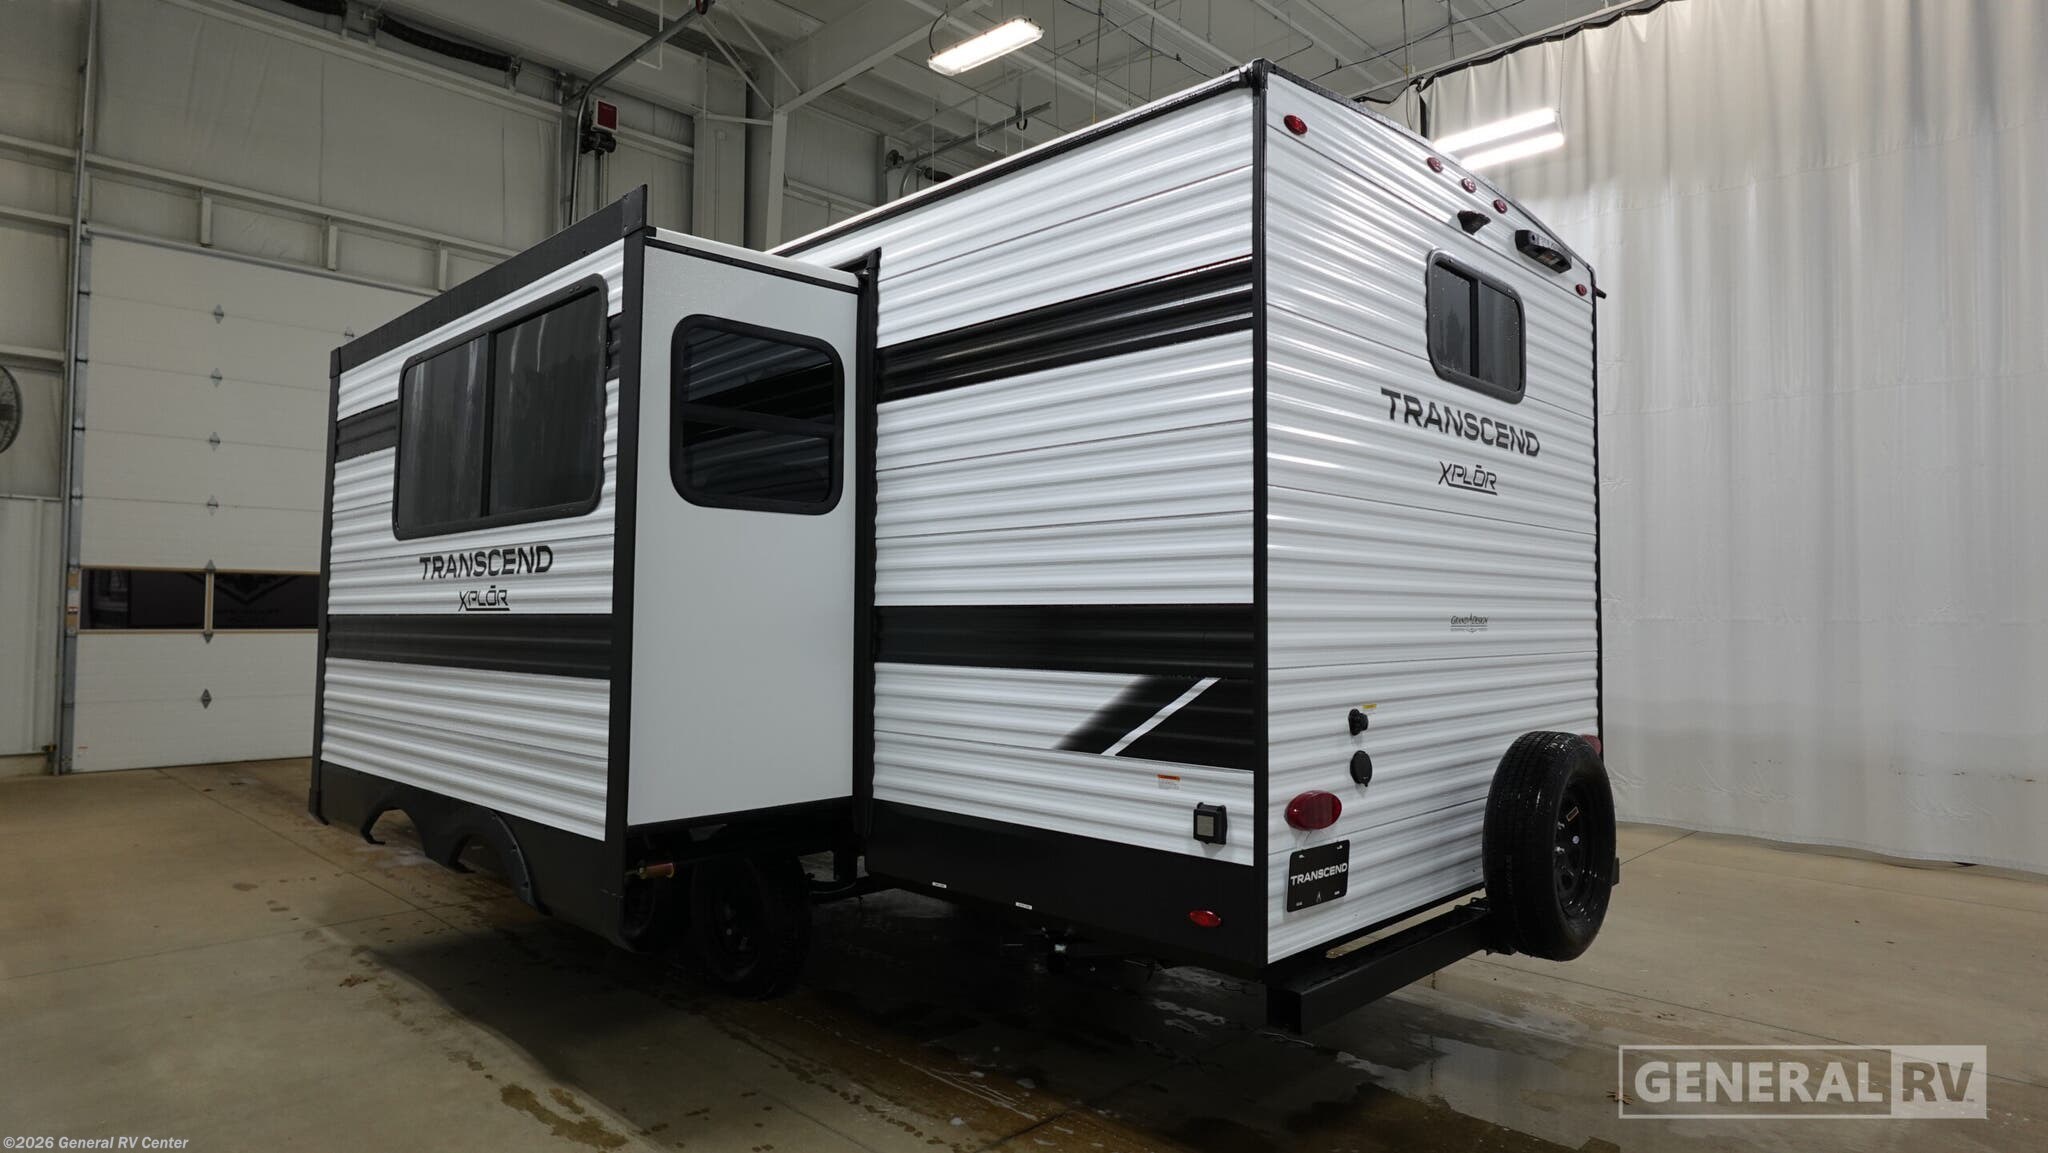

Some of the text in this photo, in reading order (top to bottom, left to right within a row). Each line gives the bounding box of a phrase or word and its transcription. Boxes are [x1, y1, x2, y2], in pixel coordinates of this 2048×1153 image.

[1380, 387, 1541, 457] TRANSCEND
[419, 545, 554, 580] TRANSCEND
[1290, 862, 1348, 886] TRANSCEND
